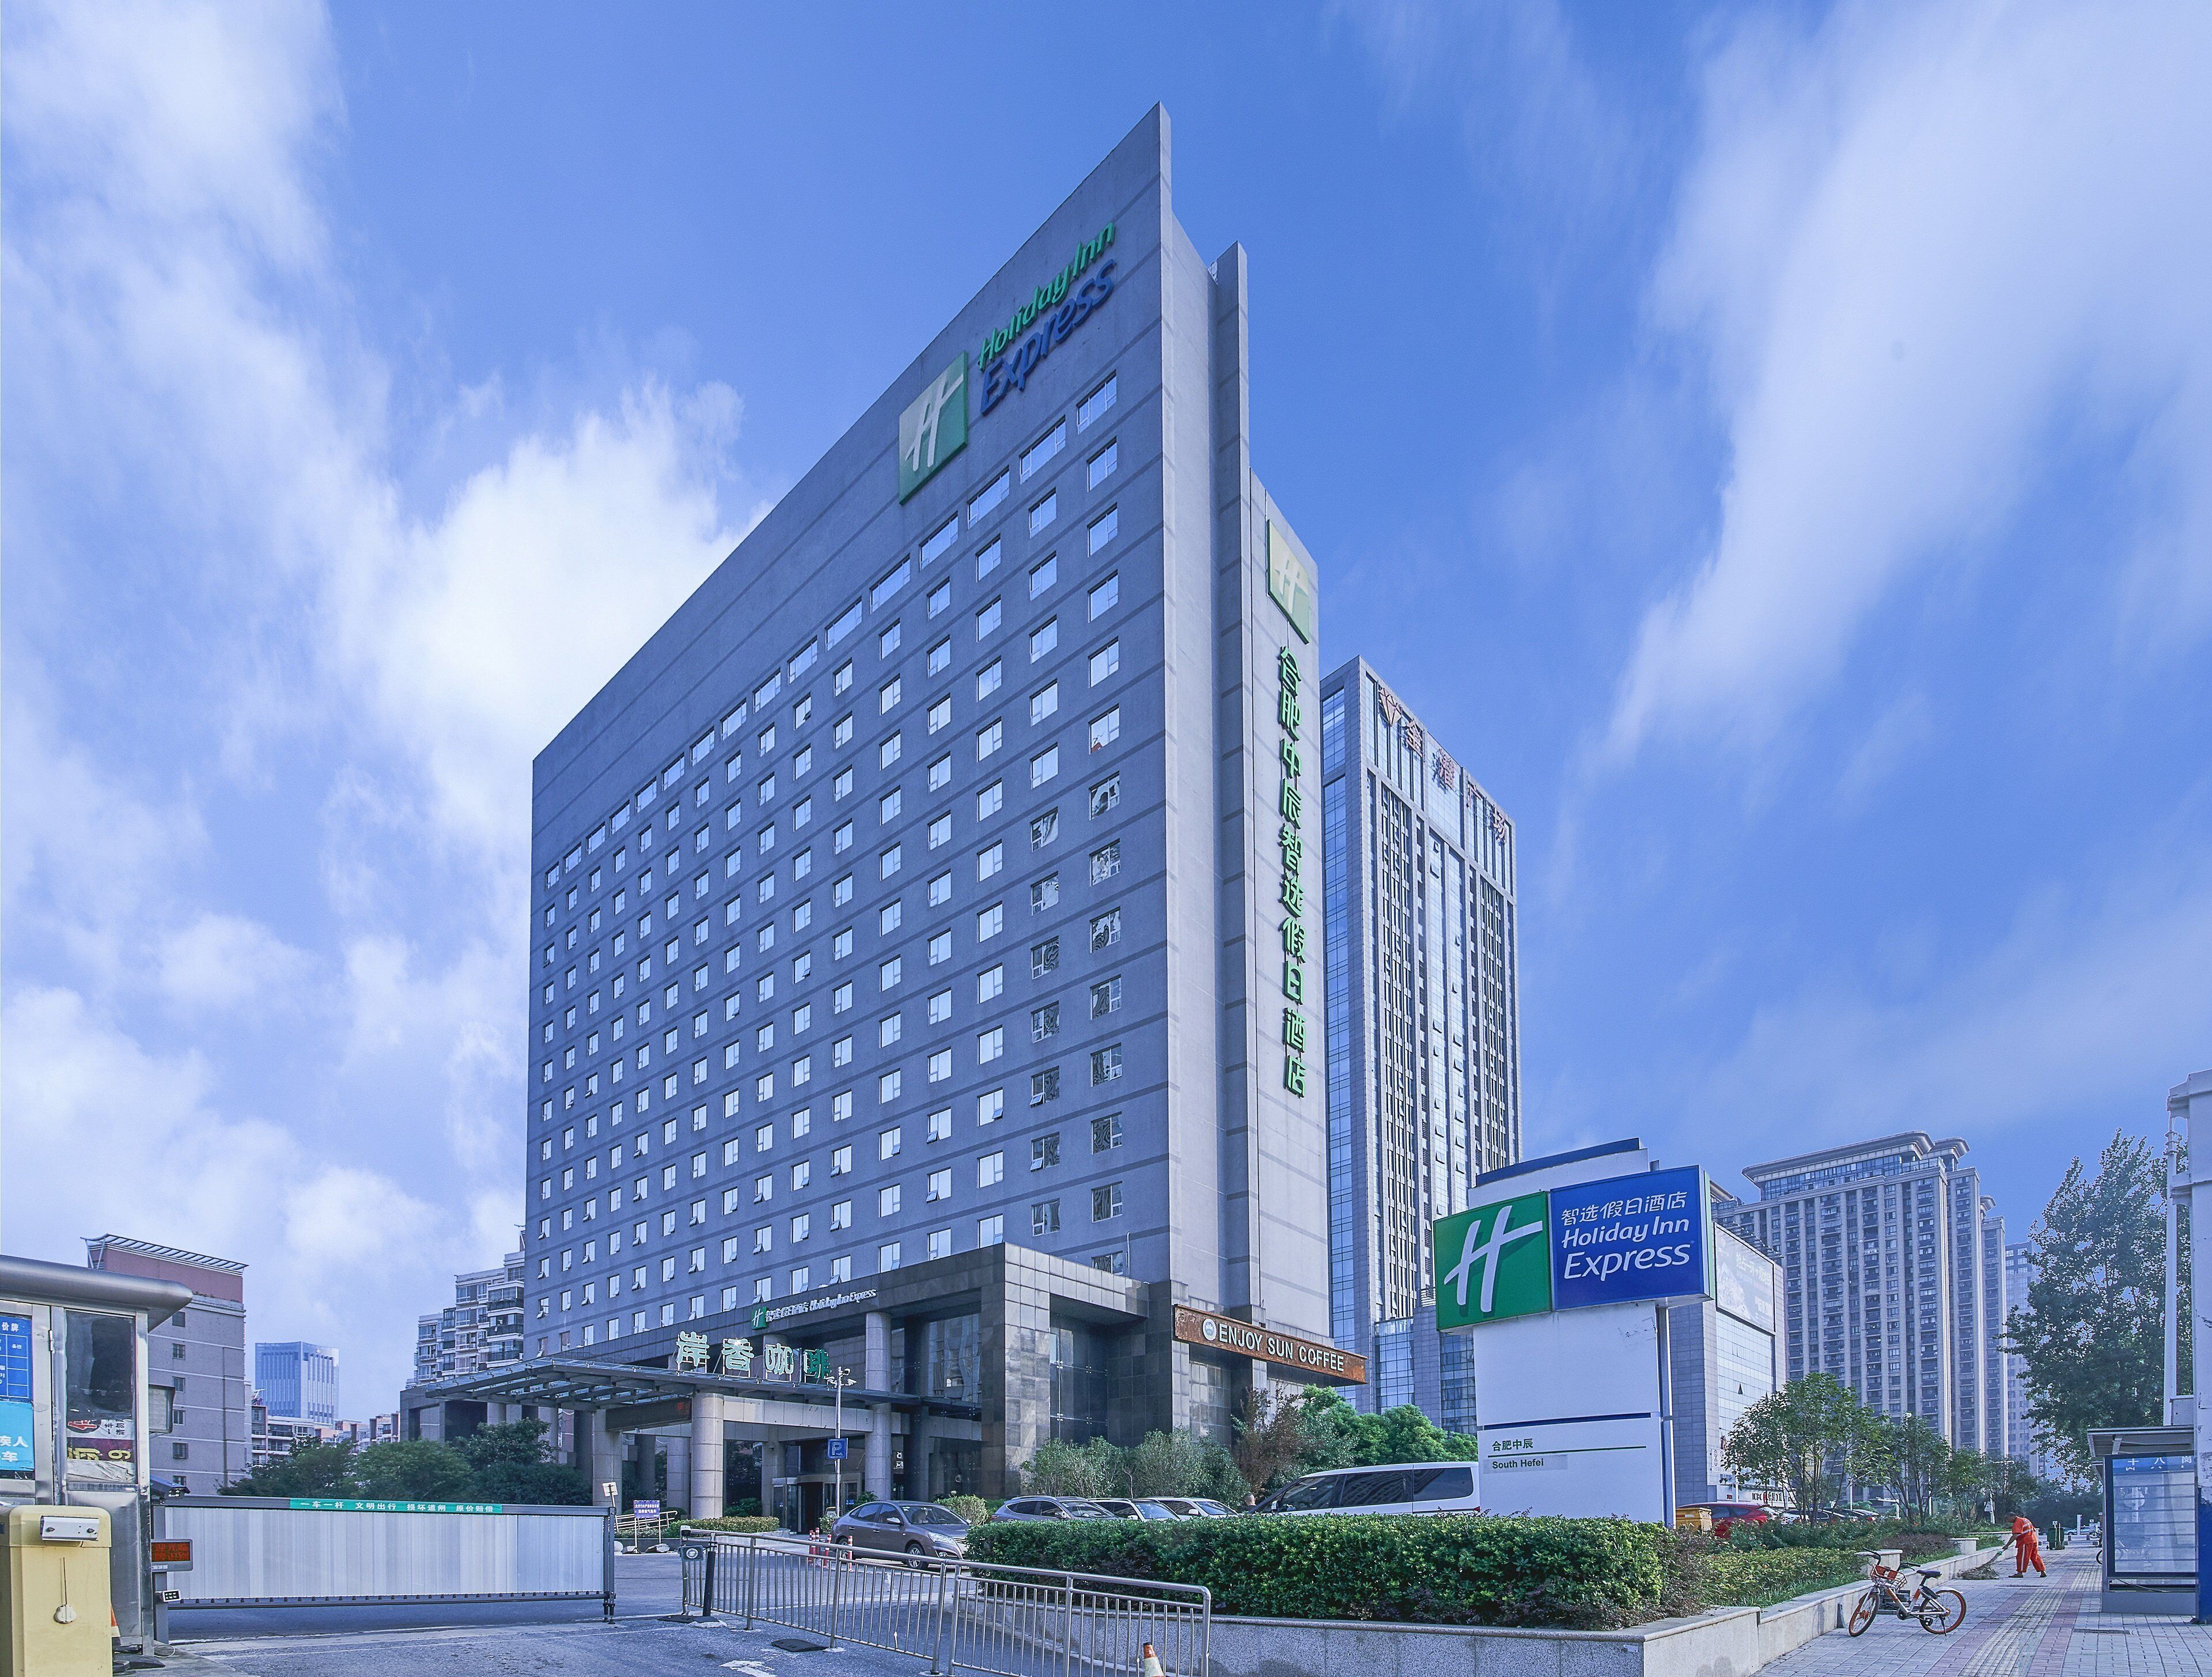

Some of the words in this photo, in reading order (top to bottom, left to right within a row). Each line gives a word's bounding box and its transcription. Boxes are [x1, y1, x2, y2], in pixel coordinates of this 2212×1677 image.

[978, 263, 1071, 370] Holiday
[1071, 222, 1115, 277] Inn
[980, 258, 1116, 415] Express
[1279, 646, 1307, 1098] 合肥中辰智选假日酒店
[1560, 1191, 1688, 1226] 智选假日酒店
[1562, 1221, 1650, 1249] Holiday
[1652, 1216, 1689, 1236] Inn
[1564, 1244, 1691, 1281] Express
[676, 1331, 832, 1379] 岸香咖啡
[1219, 1323, 1263, 1352] ENJOY
[1268, 1337, 1293, 1360] SUN
[1299, 1346, 1344, 1372] COFFEE
[1491, 1438, 1534, 1450] 合肥中辰
[1491, 1459, 1517, 1469] South
[1520, 1458, 1544, 1467] Hefei
[300, 1501, 344, 1509] 一车一杆
[355, 1502, 397, 1511] 文明出行
[407, 1503, 446, 1512] 损坏道闸
